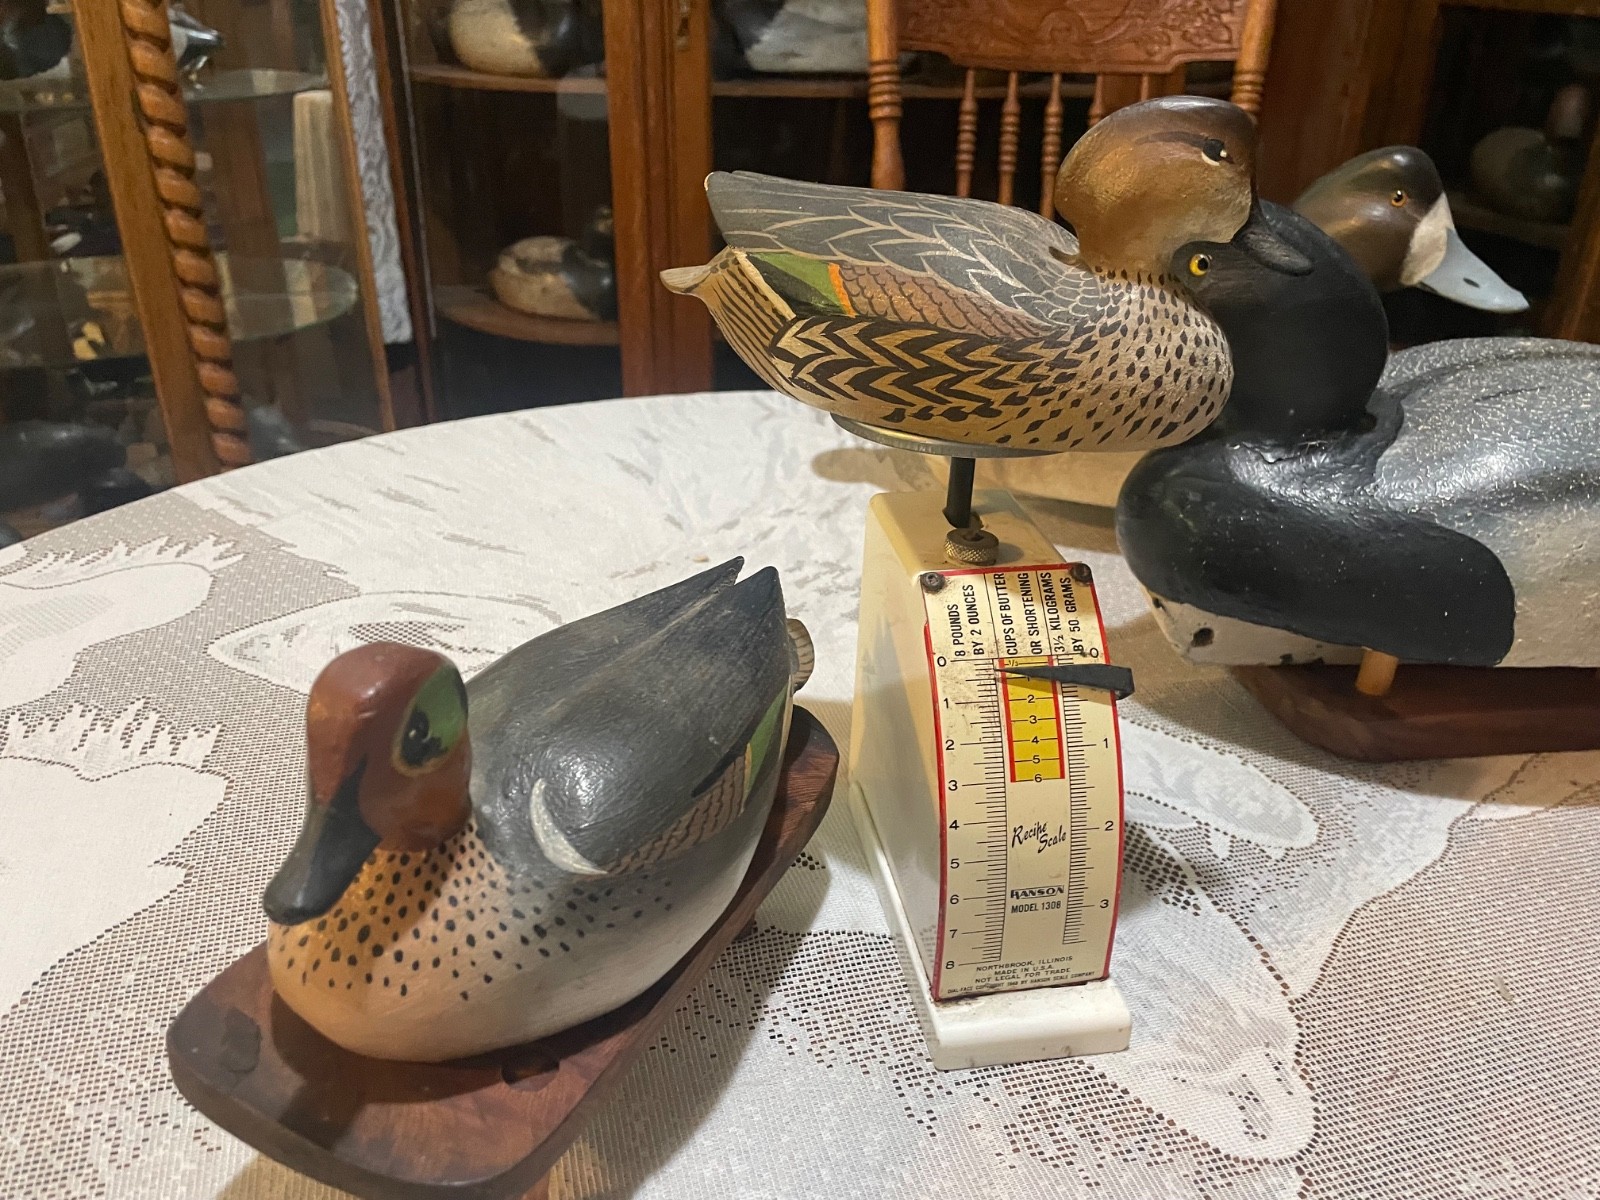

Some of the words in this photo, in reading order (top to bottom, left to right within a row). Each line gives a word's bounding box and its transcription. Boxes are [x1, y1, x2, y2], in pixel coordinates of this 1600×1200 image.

[993, 573, 1011, 611] BUTTER
[1060, 577, 1077, 613] GRAMS
[962, 584, 980, 625] OUNCES
[1018, 573, 1039, 636] SHORTENING
[1040, 572, 1061, 630] KILOGRAMS
[947, 604, 964, 645] POUNDS
[1000, 613, 1013, 625] OF
[1068, 620, 1080, 632] 50
[1003, 628, 1018, 655] CUPS
[1071, 638, 1084, 653] BY
[972, 641, 984, 655] BY
[1030, 641, 1042, 655] OR
[1089, 647, 1099, 658] 0
[937, 656, 947, 667] 0
[943, 698, 949, 709] 1
[1027, 695, 1035, 703] 2
[1029, 715, 1038, 724] 3
[945, 740, 955, 750] 2
[1031, 736, 1040, 744] 4
[1103, 738, 1109, 748] 1
[1032, 755, 1040, 764] 5
[1034, 774, 1042, 782] 6
[948, 780, 958, 791] 3
[949, 820, 960, 830] 4
[1104, 821, 1114, 831] 2
[1011, 821, 1047, 848] Recipe
[1037, 825, 1066, 853] Scale
[950, 858, 960, 869] 5
[1010, 885, 1065, 899] HANSON
[949, 895, 960, 905] 6
[1100, 900, 1109, 909] 3
[1011, 903, 1038, 913] MODEL
[1041, 901, 1061, 910] 1308
[950, 929, 958, 939] 7
[945, 961, 955, 970] 8
[1038, 956, 1073, 964] ILLINOIS
